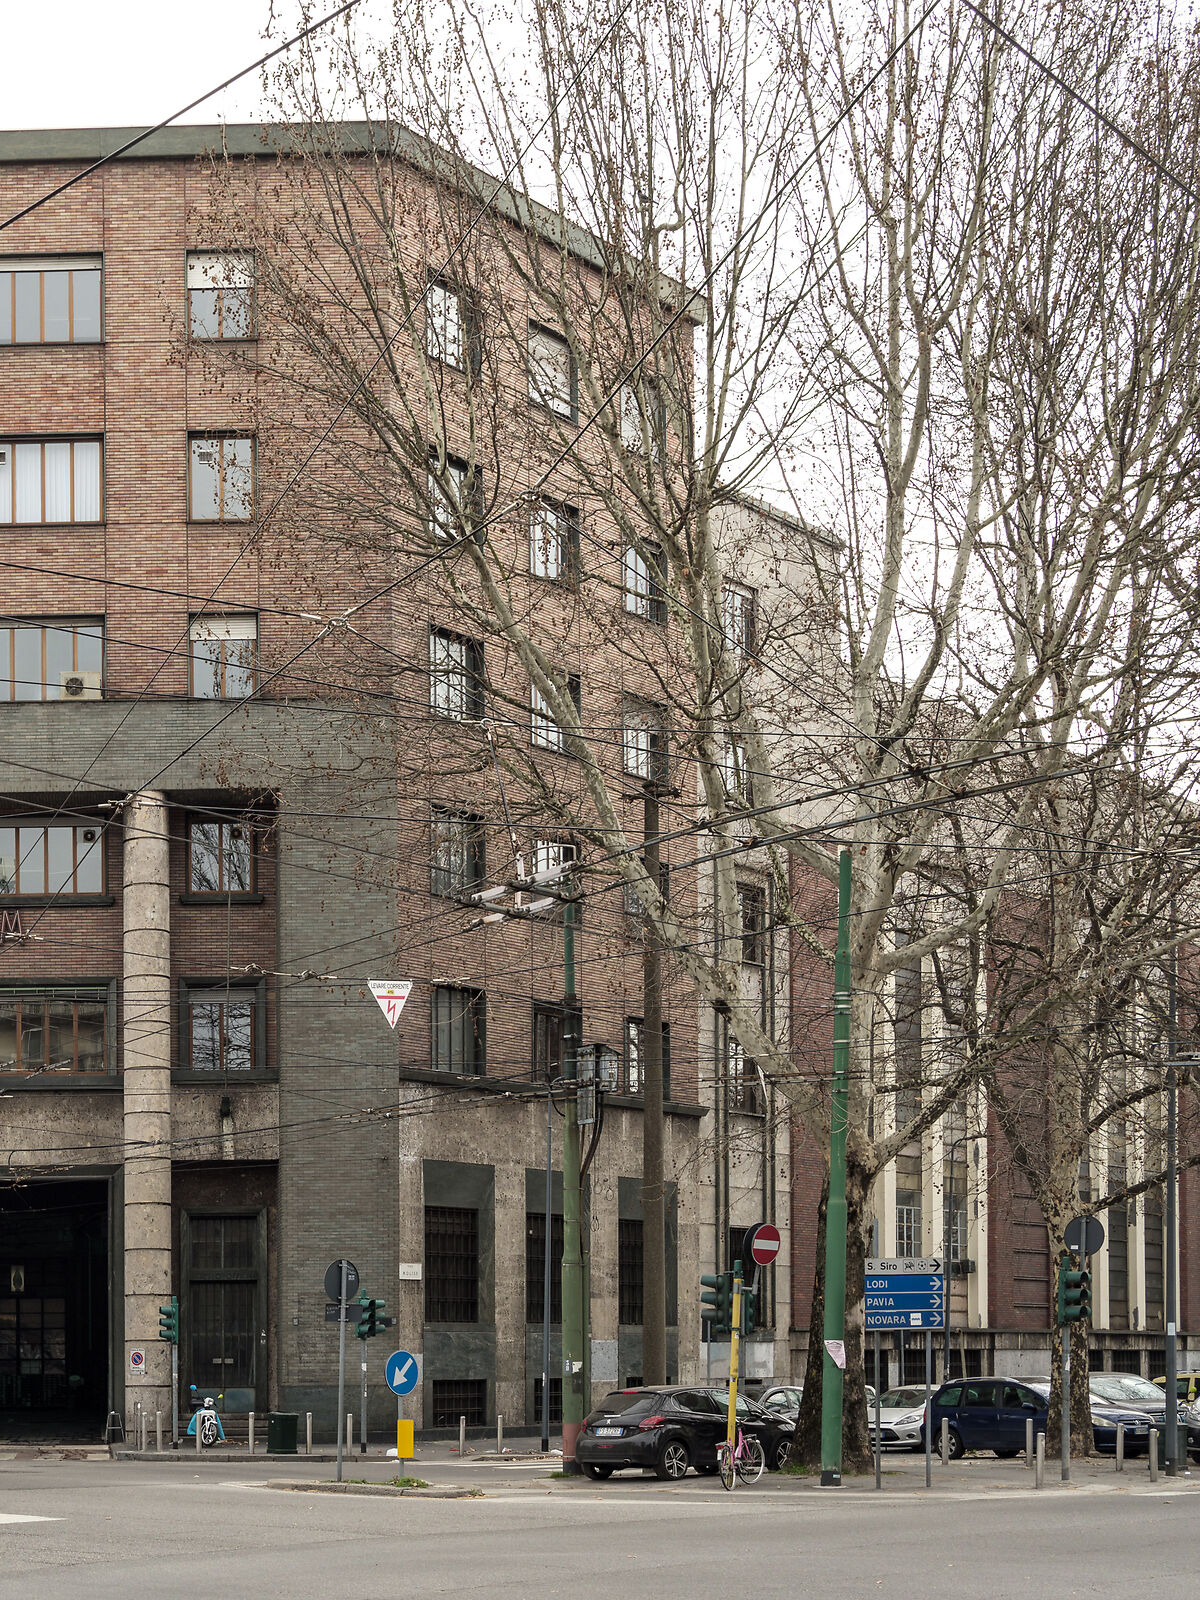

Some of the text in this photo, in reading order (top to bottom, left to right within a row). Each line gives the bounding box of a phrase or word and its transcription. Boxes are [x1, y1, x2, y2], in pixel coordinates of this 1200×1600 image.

[867, 1262, 898, 1271] S. Siro
[866, 1280, 888, 1289] LODI
[866, 1297, 895, 1307] PAVIA
[867, 1315, 906, 1325] NOVARA
